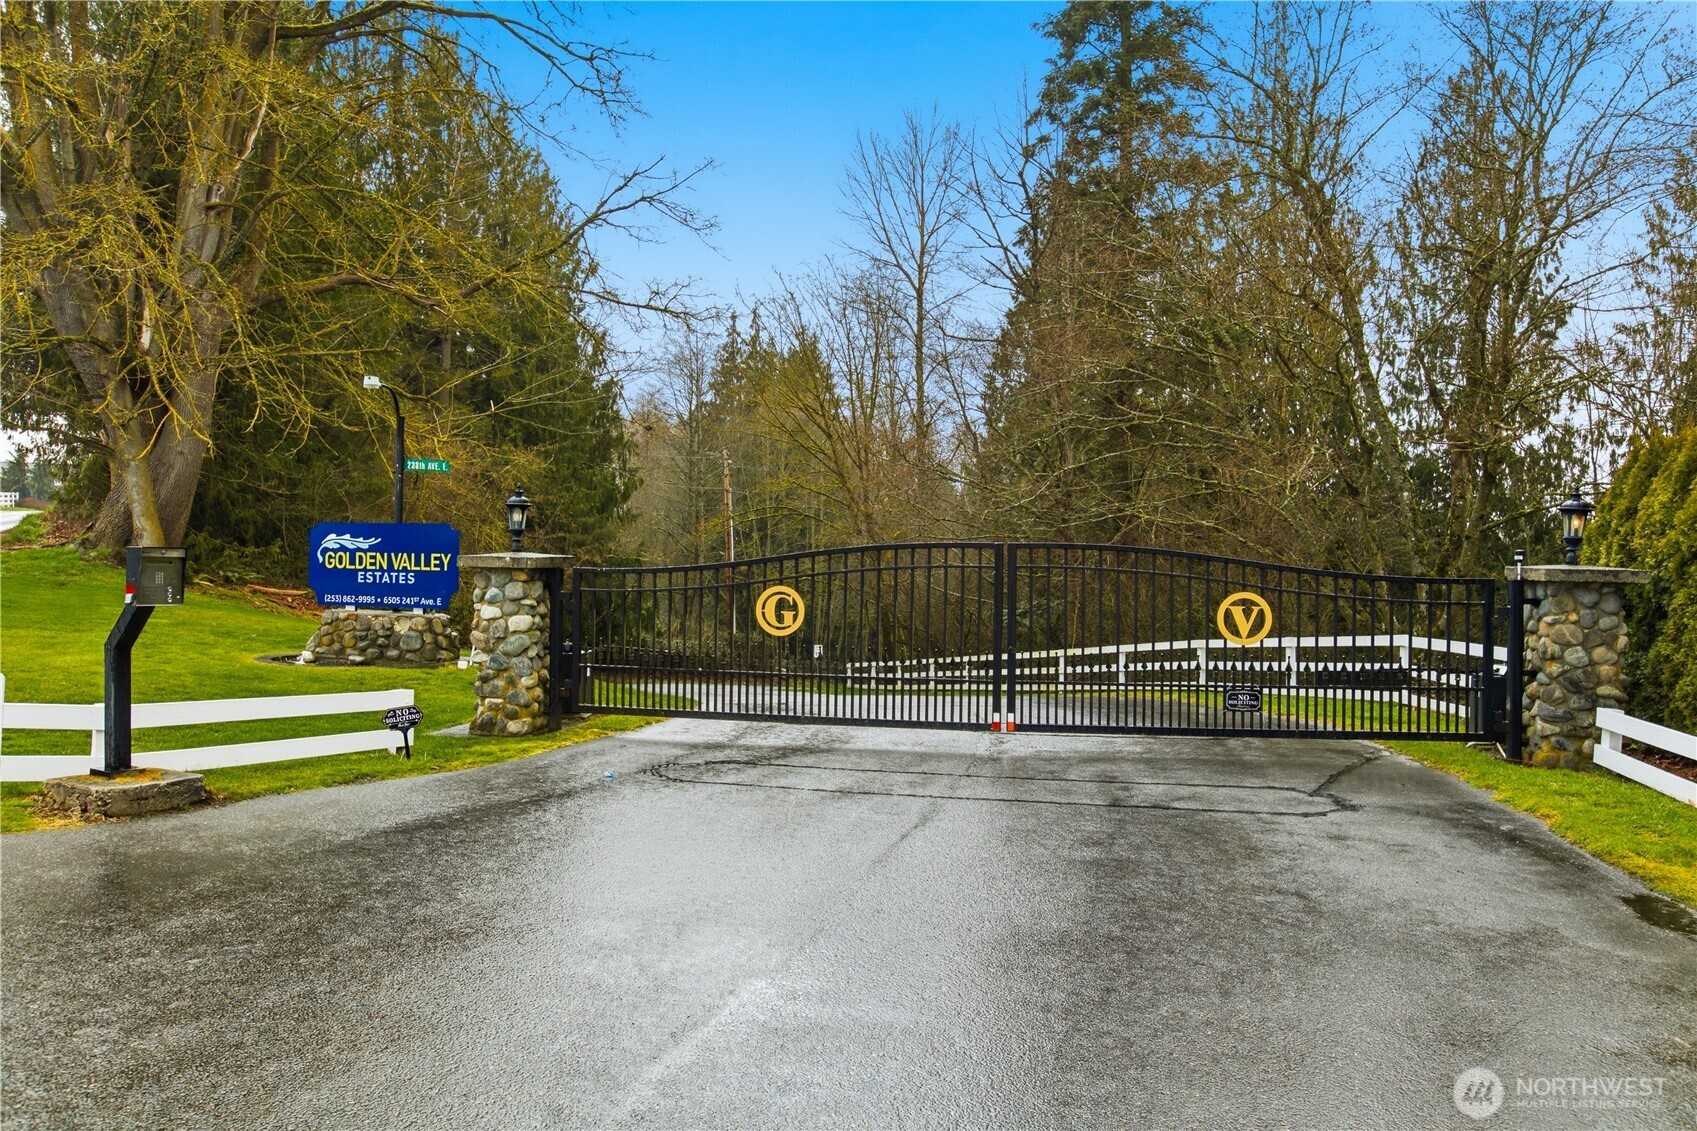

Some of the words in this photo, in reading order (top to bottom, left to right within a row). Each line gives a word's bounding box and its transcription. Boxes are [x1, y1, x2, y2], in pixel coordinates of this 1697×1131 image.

[428, 462, 441, 470] AVE.
[325, 552, 388, 570] GOLDEN
[391, 552, 452, 571] VALLEY
[358, 572, 415, 584] ESTATES
[324, 594, 342, 603] (253)
[343, 595, 375, 603] 862-9995
[384, 596, 400, 604] 6505
[765, 594, 796, 628] G
[1228, 606, 1262, 638] V
[396, 708, 409, 716] NO
[386, 714, 420, 723] SOLICITING
